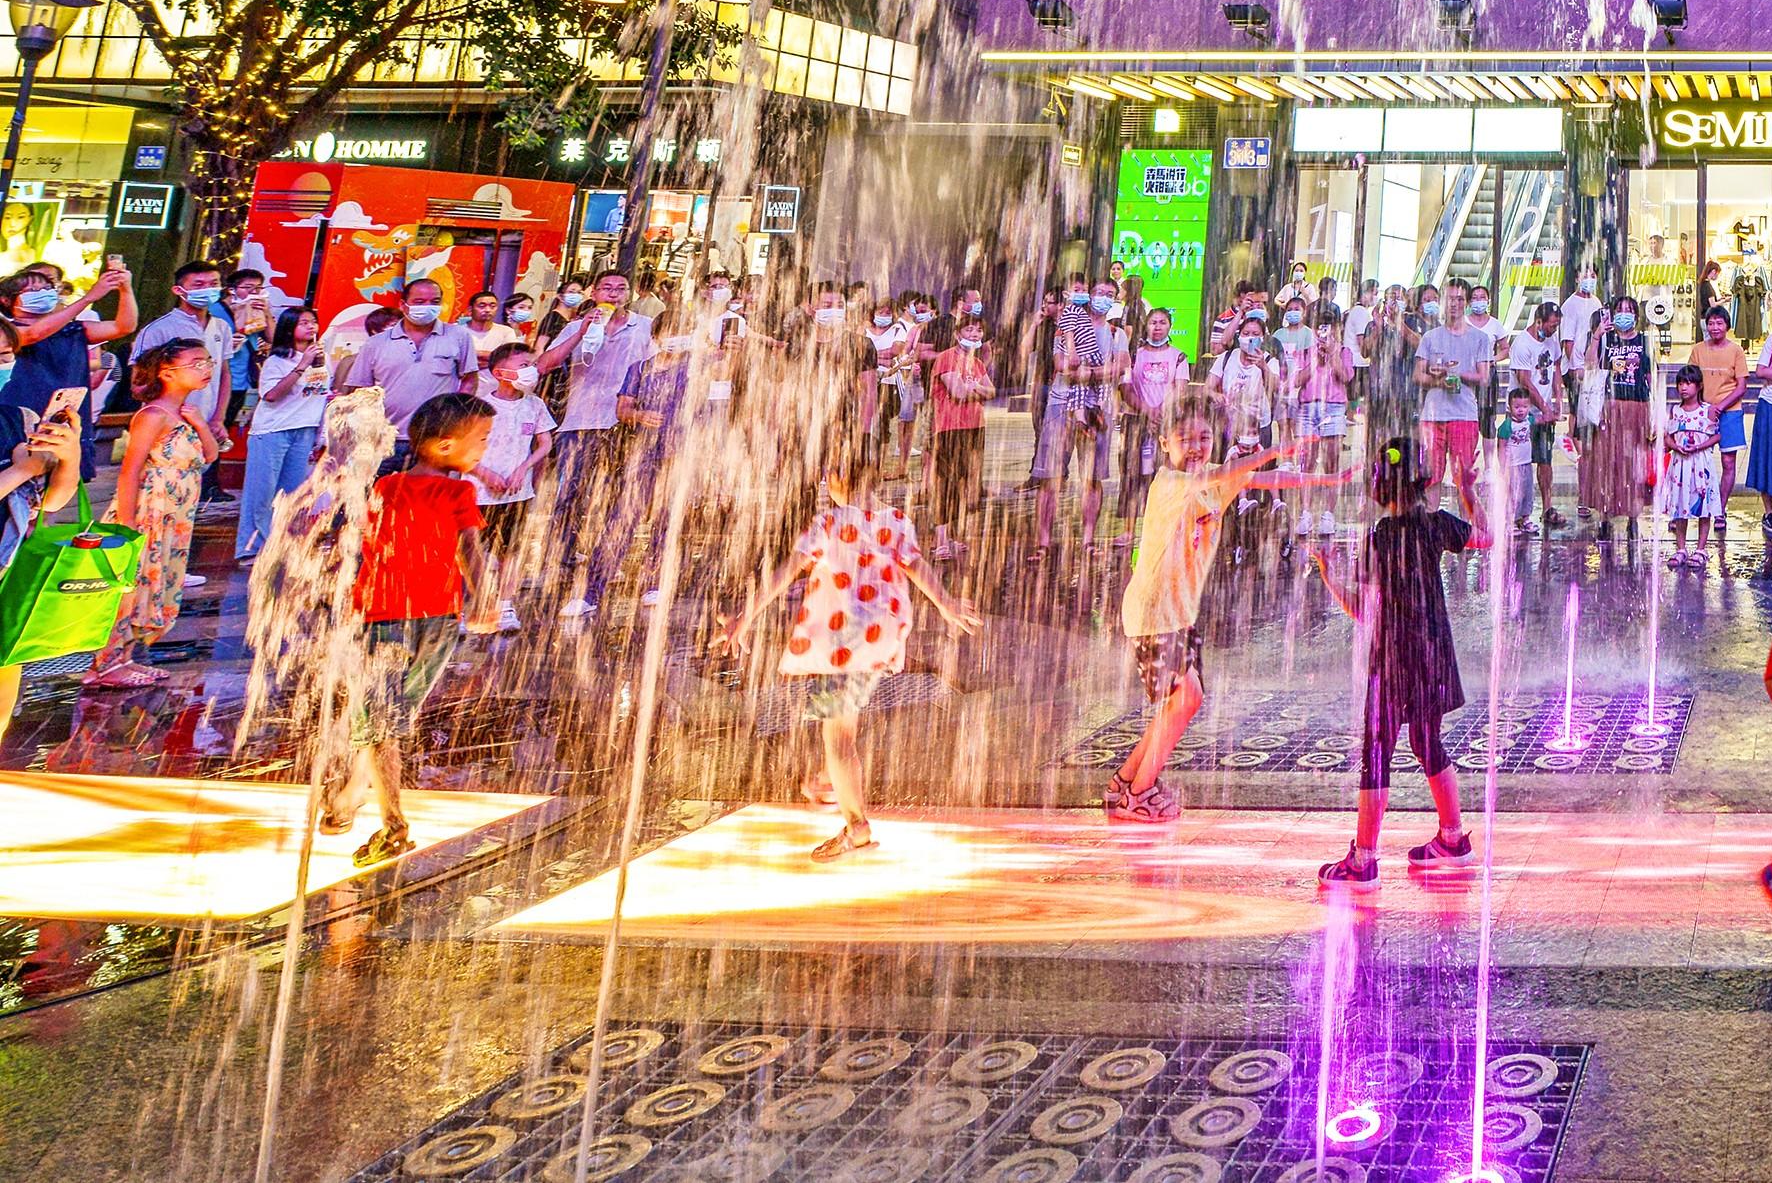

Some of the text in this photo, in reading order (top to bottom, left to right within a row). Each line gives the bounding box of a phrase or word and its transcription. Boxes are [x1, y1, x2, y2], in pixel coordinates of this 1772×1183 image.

[334, 140, 427, 159] HOMME
[560, 137, 722, 163] 莱克斯顿
[1608, 345, 1643, 357] FRIENDS
